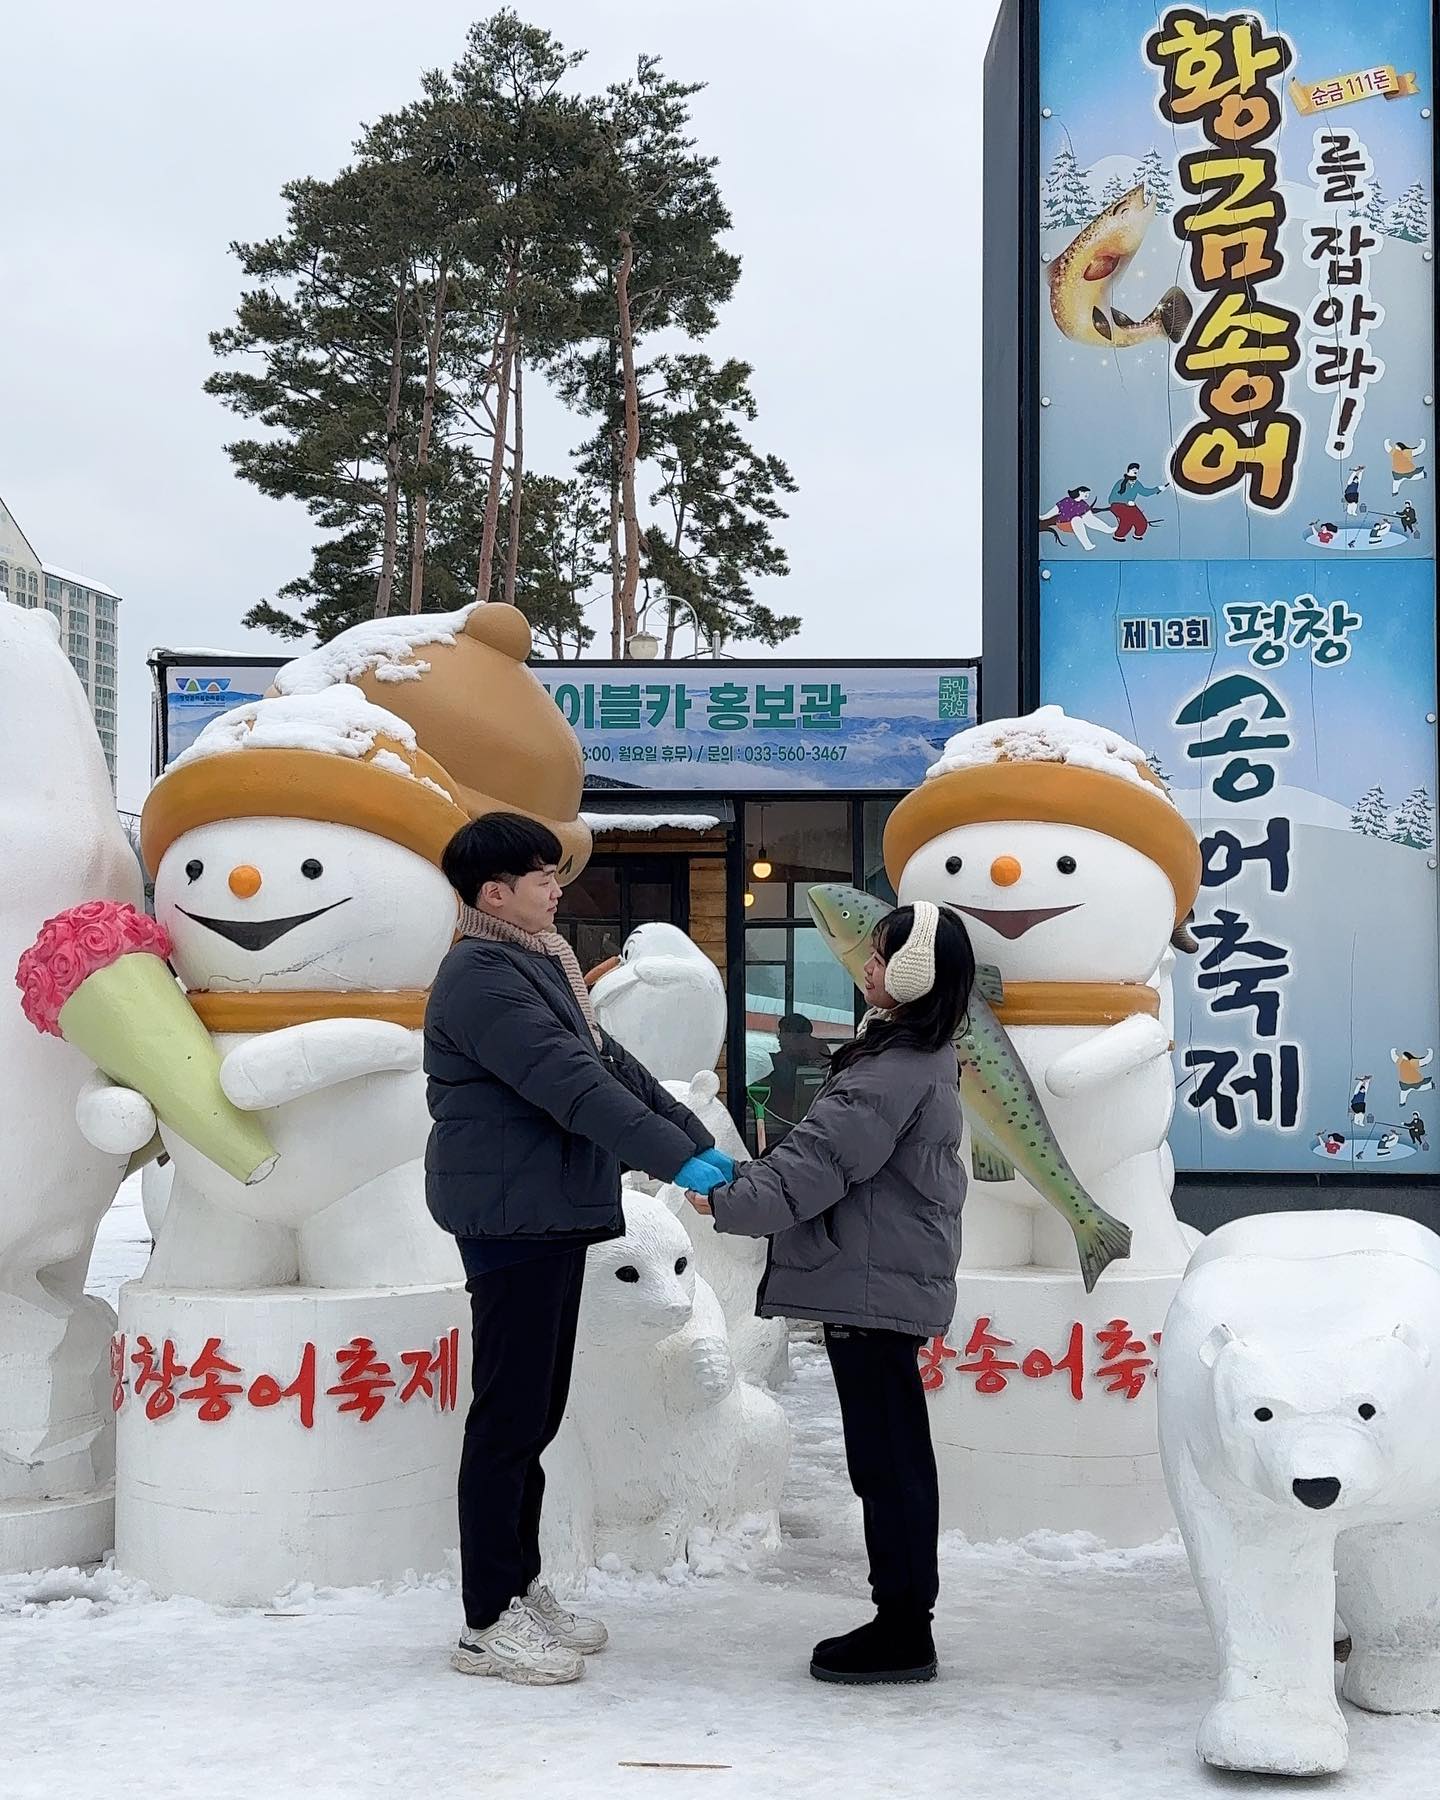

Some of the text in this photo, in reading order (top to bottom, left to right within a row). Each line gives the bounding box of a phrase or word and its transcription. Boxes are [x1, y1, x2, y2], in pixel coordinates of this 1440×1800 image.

[1312, 70, 1390, 105] 순금 111돈
[1147, 10, 1300, 508] 황금송어
[1310, 135, 1377, 450] 를 잡아라!
[1121, 599, 1359, 664] 제13회 평창
[543, 682, 847, 730] 이블카 홍보관
[619, 746, 657, 761] 월요일
[661, 745, 693, 763] 휴무)
[708, 746, 733, 761] 문의
[744, 745, 848, 762] 033-560-3467
[1175, 674, 1301, 1130] 송어축제
